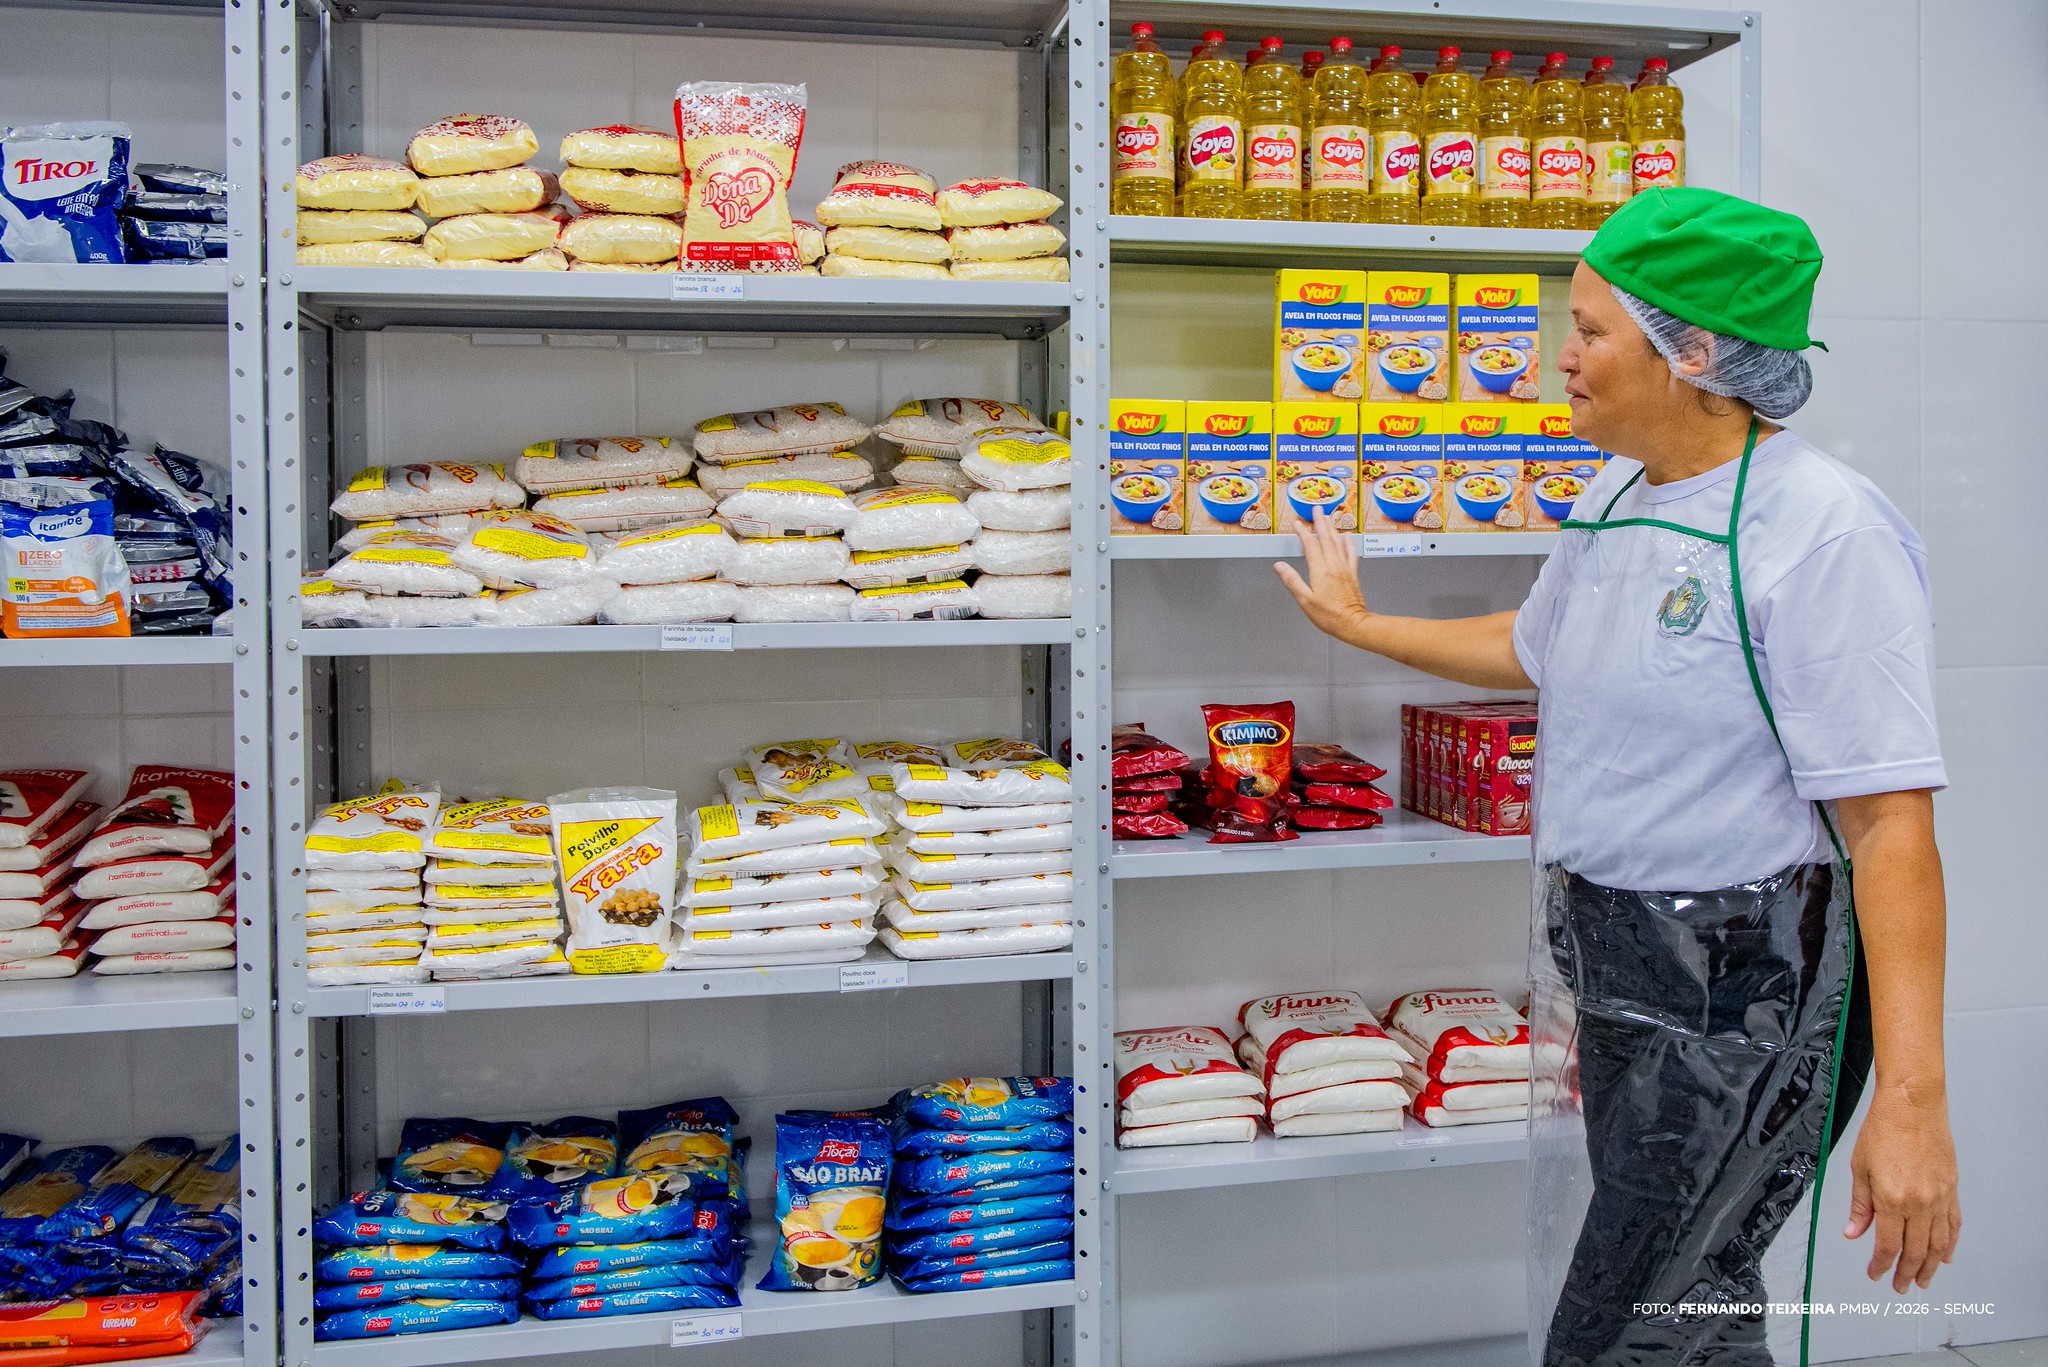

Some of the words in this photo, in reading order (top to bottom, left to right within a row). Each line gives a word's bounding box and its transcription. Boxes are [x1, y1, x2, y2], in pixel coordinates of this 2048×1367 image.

[1117, 131, 1157, 150] Soya
[1192, 135, 1233, 156] Soya
[1253, 142, 1295, 161] Soya
[1324, 142, 1365, 162] Soya
[1432, 149, 1472, 168] Soya
[1542, 153, 1582, 172] Soya
[1634, 157, 1674, 175] Soya
[14, 158, 99, 185] TIROL
[701, 175, 762, 208] Dona
[718, 197, 753, 230] Dê
[1304, 284, 1337, 301] Yoki
[1389, 287, 1422, 304] Yoki
[1479, 288, 1512, 304] Yoki
[1284, 312, 1305, 321] AVEIA
[1306, 312, 1316, 321] EM
[1316, 312, 1342, 321] FLOCOS
[1342, 312, 1362, 321] FINOS
[1370, 314, 1390, 323] AVEIA
[1390, 314, 1400, 323] EM
[1401, 314, 1426, 323] FLOCOS
[1426, 314, 1446, 323] FINOS
[1460, 316, 1480, 324] AVEIA
[1481, 316, 1491, 324] EM
[1492, 316, 1516, 324] FLOCOS
[1516, 316, 1536, 324] FINOS
[1122, 414, 1156, 430] Yoki
[1209, 416, 1244, 432] Yoki
[1298, 417, 1332, 432] Yoki
[1382, 416, 1416, 432] Yoki
[1464, 416, 1497, 432] Yoki
[1543, 419, 1572, 432] Yok
[1124, 442, 1134, 451] EM
[1135, 442, 1162, 451] FLOCOS
[1162, 442, 1182, 451] FINOS
[1190, 444, 1212, 452] AVEIA
[1212, 444, 1222, 452] EM
[1222, 444, 1248, 452] FLOCOS
[1249, 444, 1269, 452] FINOS
[1279, 444, 1300, 452] AVEIA
[1300, 444, 1310, 452] EM
[1310, 444, 1336, 452] FLOCOS
[1336, 444, 1356, 452] FINOS
[1364, 444, 1386, 452] AVEIA
[1386, 444, 1396, 452] EM
[1396, 444, 1421, 452] FLOCOS
[1421, 444, 1440, 452] FINOS
[28, 550, 62, 559] ZERO
[1220, 727, 1278, 742] KIMIMO
[132, 770, 235, 790] itamarat
[567, 822, 620, 858] Polvilho
[582, 836, 619, 861] Doce
[569, 842, 664, 904] Yara
[118, 900, 154, 912] itamarati
[1268, 996, 1351, 1020] finna
[1422, 992, 1501, 1014] finna
[1124, 1032, 1215, 1053] finna
[834, 1166, 882, 1184] BRAZ
[790, 1280, 813, 1289] 500g
[102, 1316, 137, 1329] URBANO
